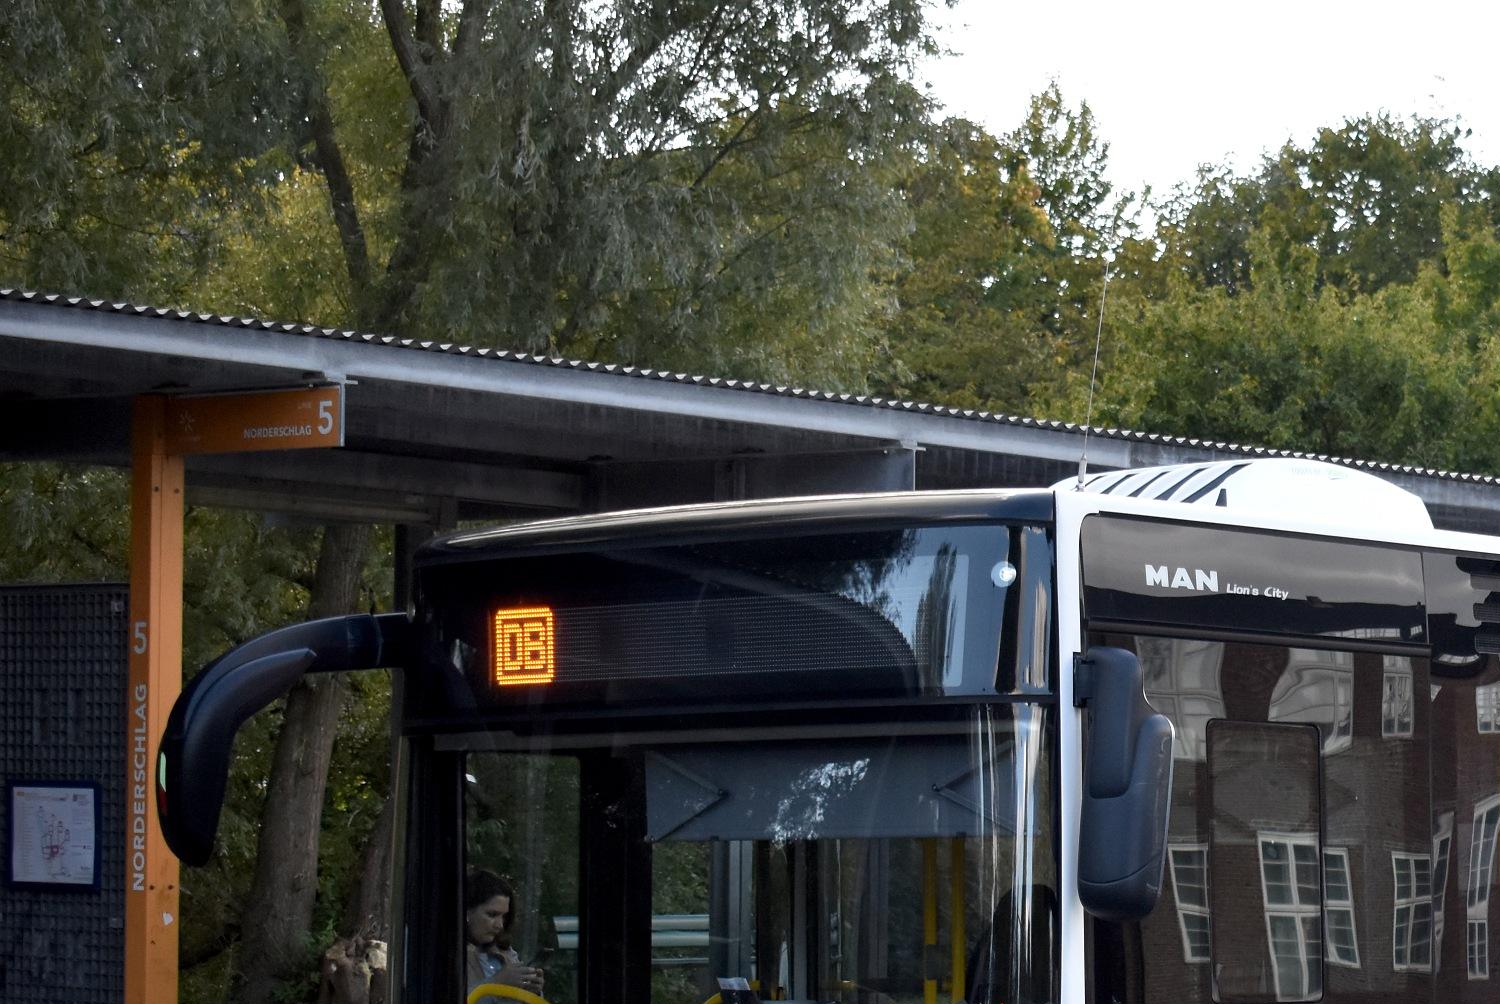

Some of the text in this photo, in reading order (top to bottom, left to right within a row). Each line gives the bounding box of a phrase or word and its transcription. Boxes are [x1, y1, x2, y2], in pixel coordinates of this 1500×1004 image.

[243, 400, 333, 438] NORDERSCHLAG 5
[1145, 564, 1290, 600] MAN Lion's City
[501, 619, 547, 672] DB
[132, 621, 147, 892] NORDERSCHLAG 5
